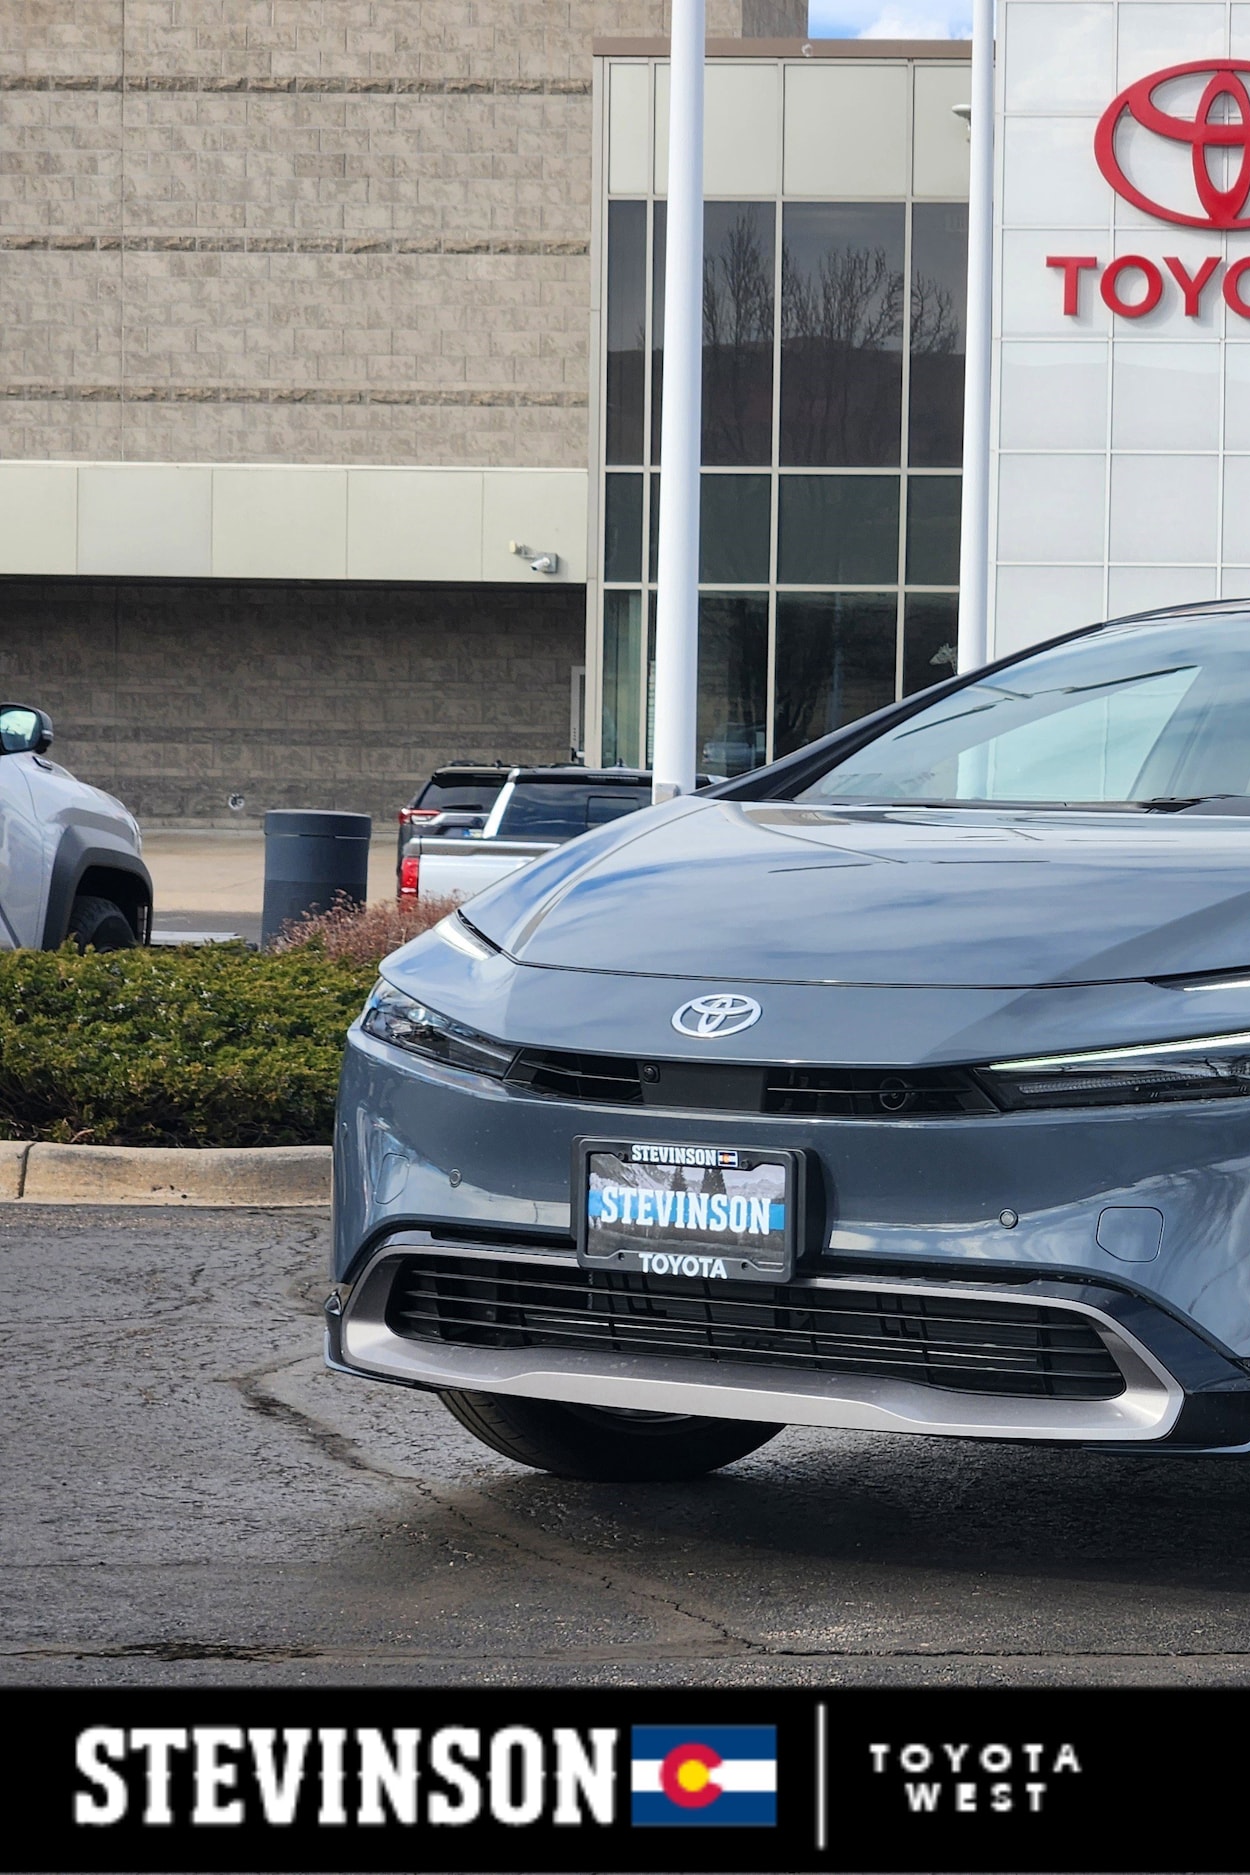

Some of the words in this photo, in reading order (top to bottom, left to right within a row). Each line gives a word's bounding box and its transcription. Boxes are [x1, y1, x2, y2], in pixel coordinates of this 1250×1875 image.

[631, 1144, 717, 1166] STEVINSON
[601, 1185, 771, 1235] STEVINSON
[638, 1252, 728, 1279] TOYOTA
